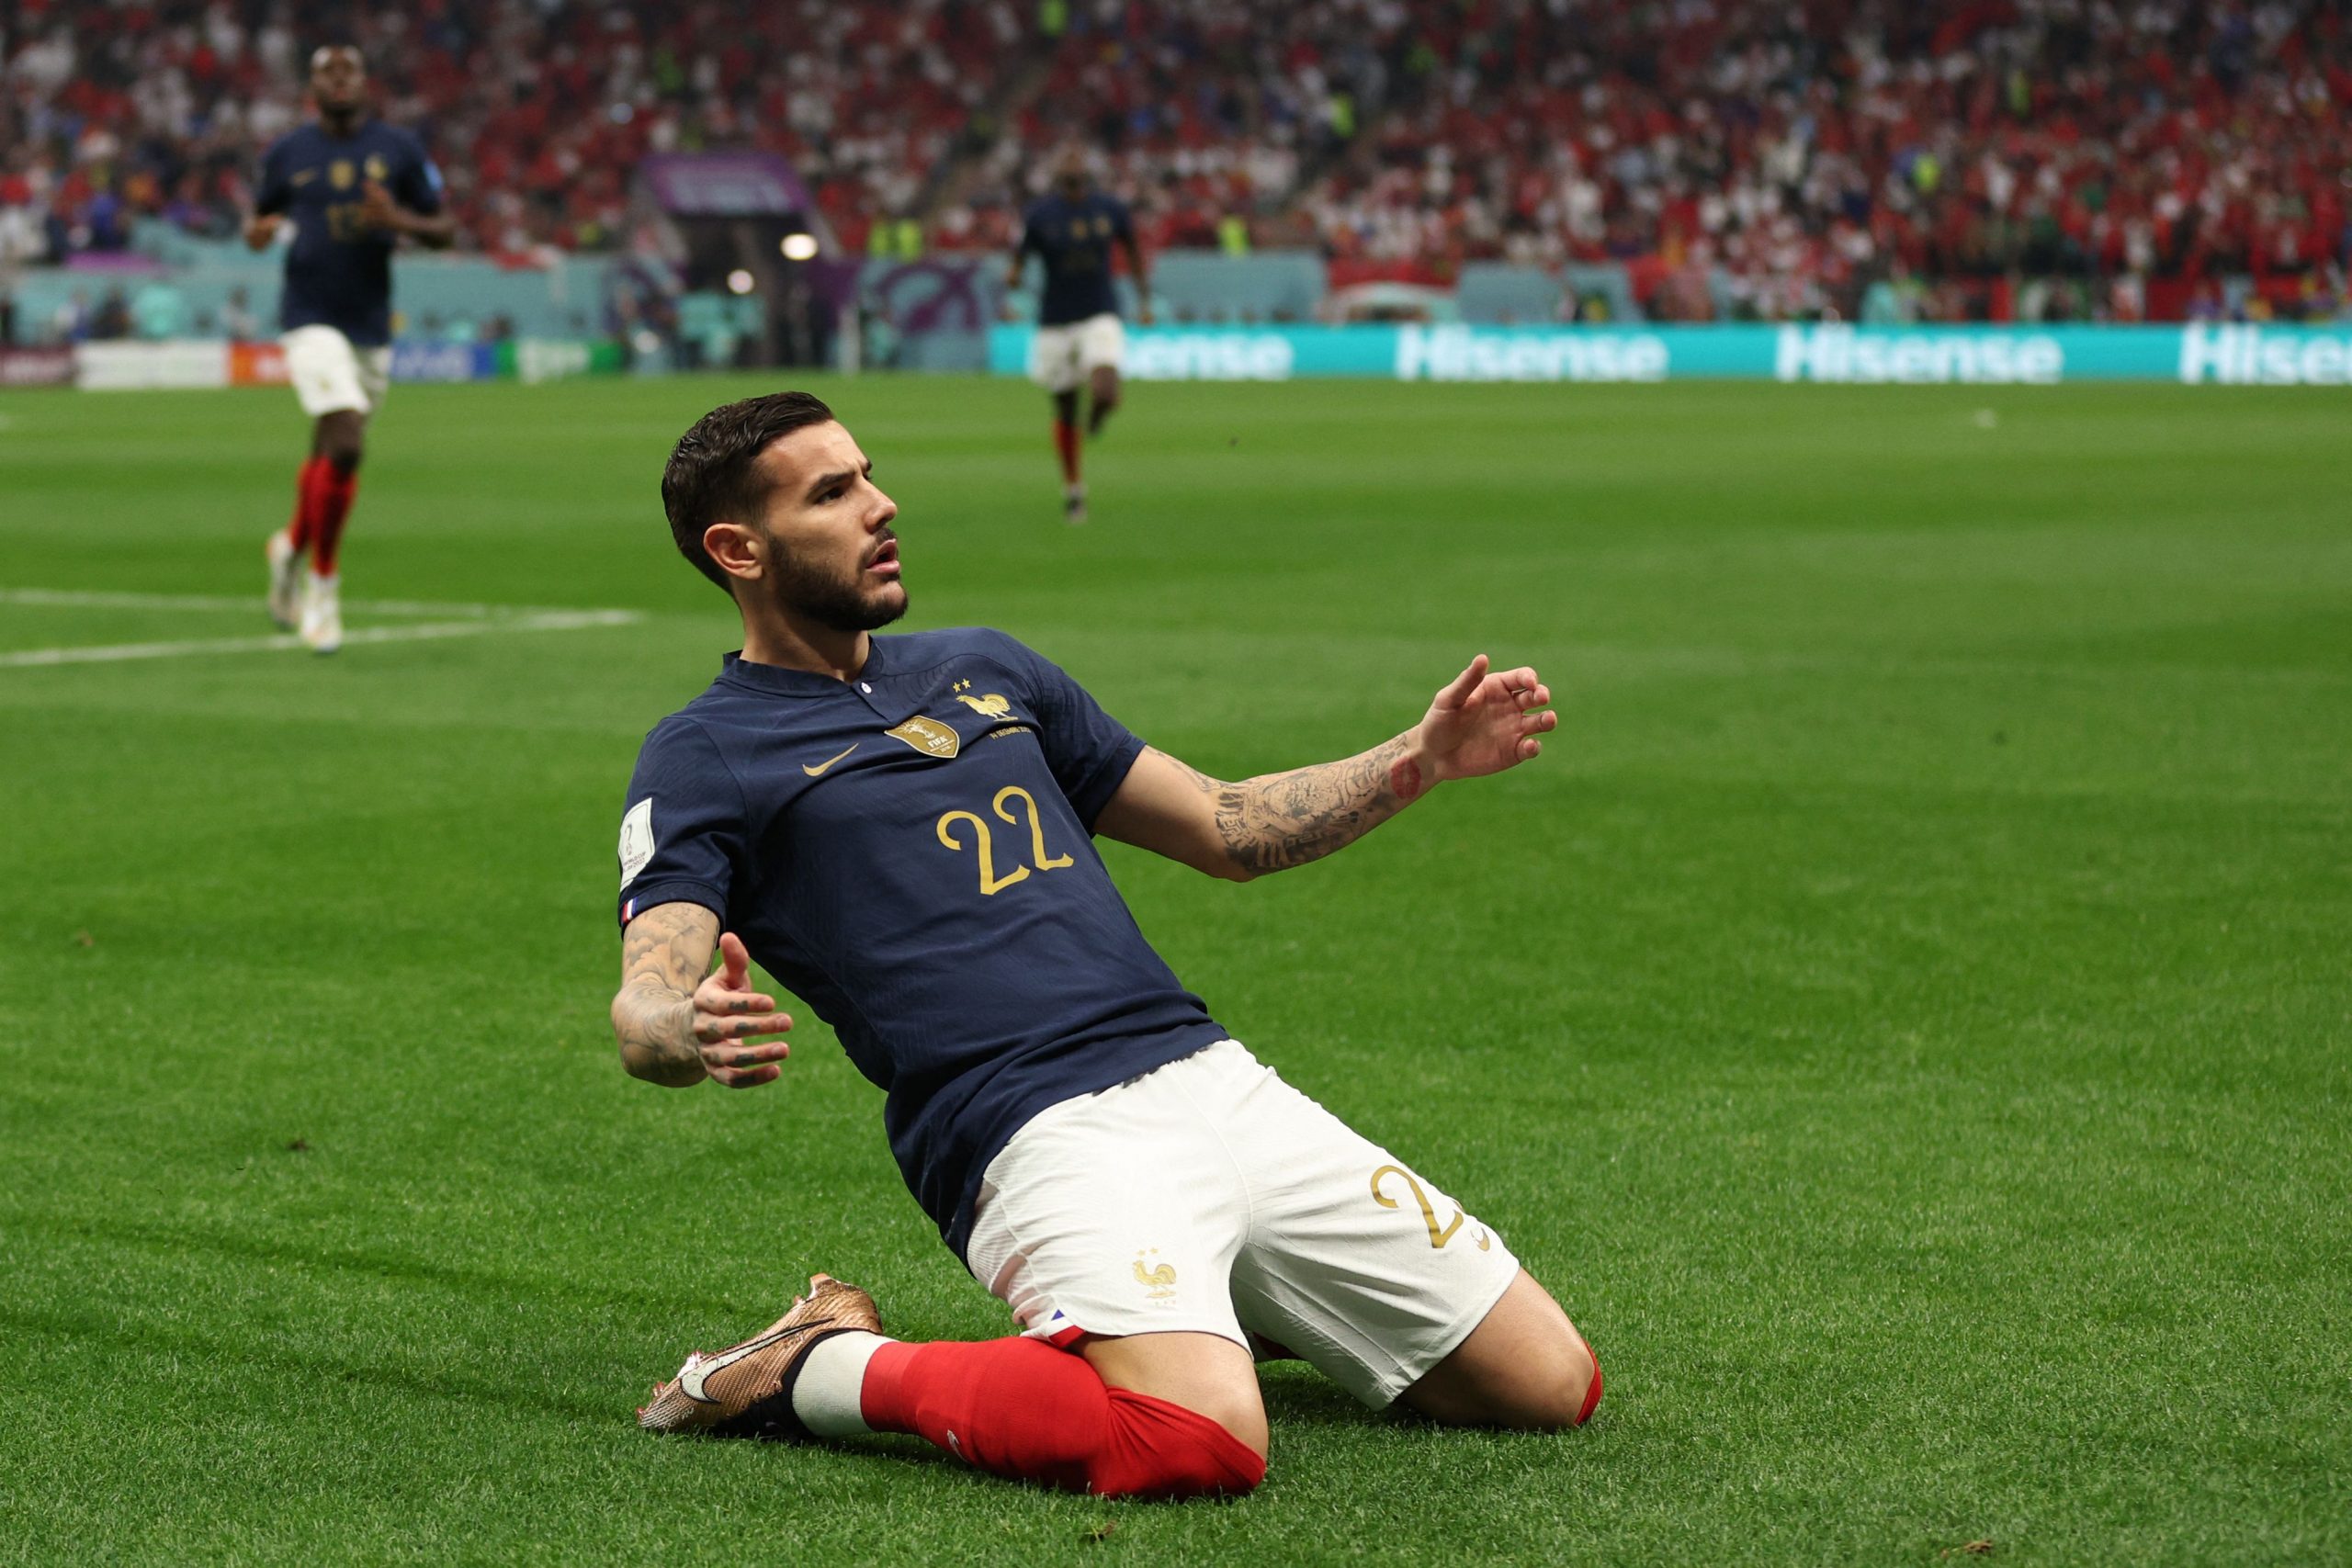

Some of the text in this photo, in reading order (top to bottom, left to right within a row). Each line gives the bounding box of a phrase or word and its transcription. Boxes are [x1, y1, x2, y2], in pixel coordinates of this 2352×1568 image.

[1125, 333, 1294, 380] ense
[1395, 322, 1668, 381] Hisense
[1775, 322, 2064, 383] Hisense
[2179, 321, 2352, 385] Hise
[936, 785, 1074, 896] 22
[1370, 1165, 1489, 1251] 2
